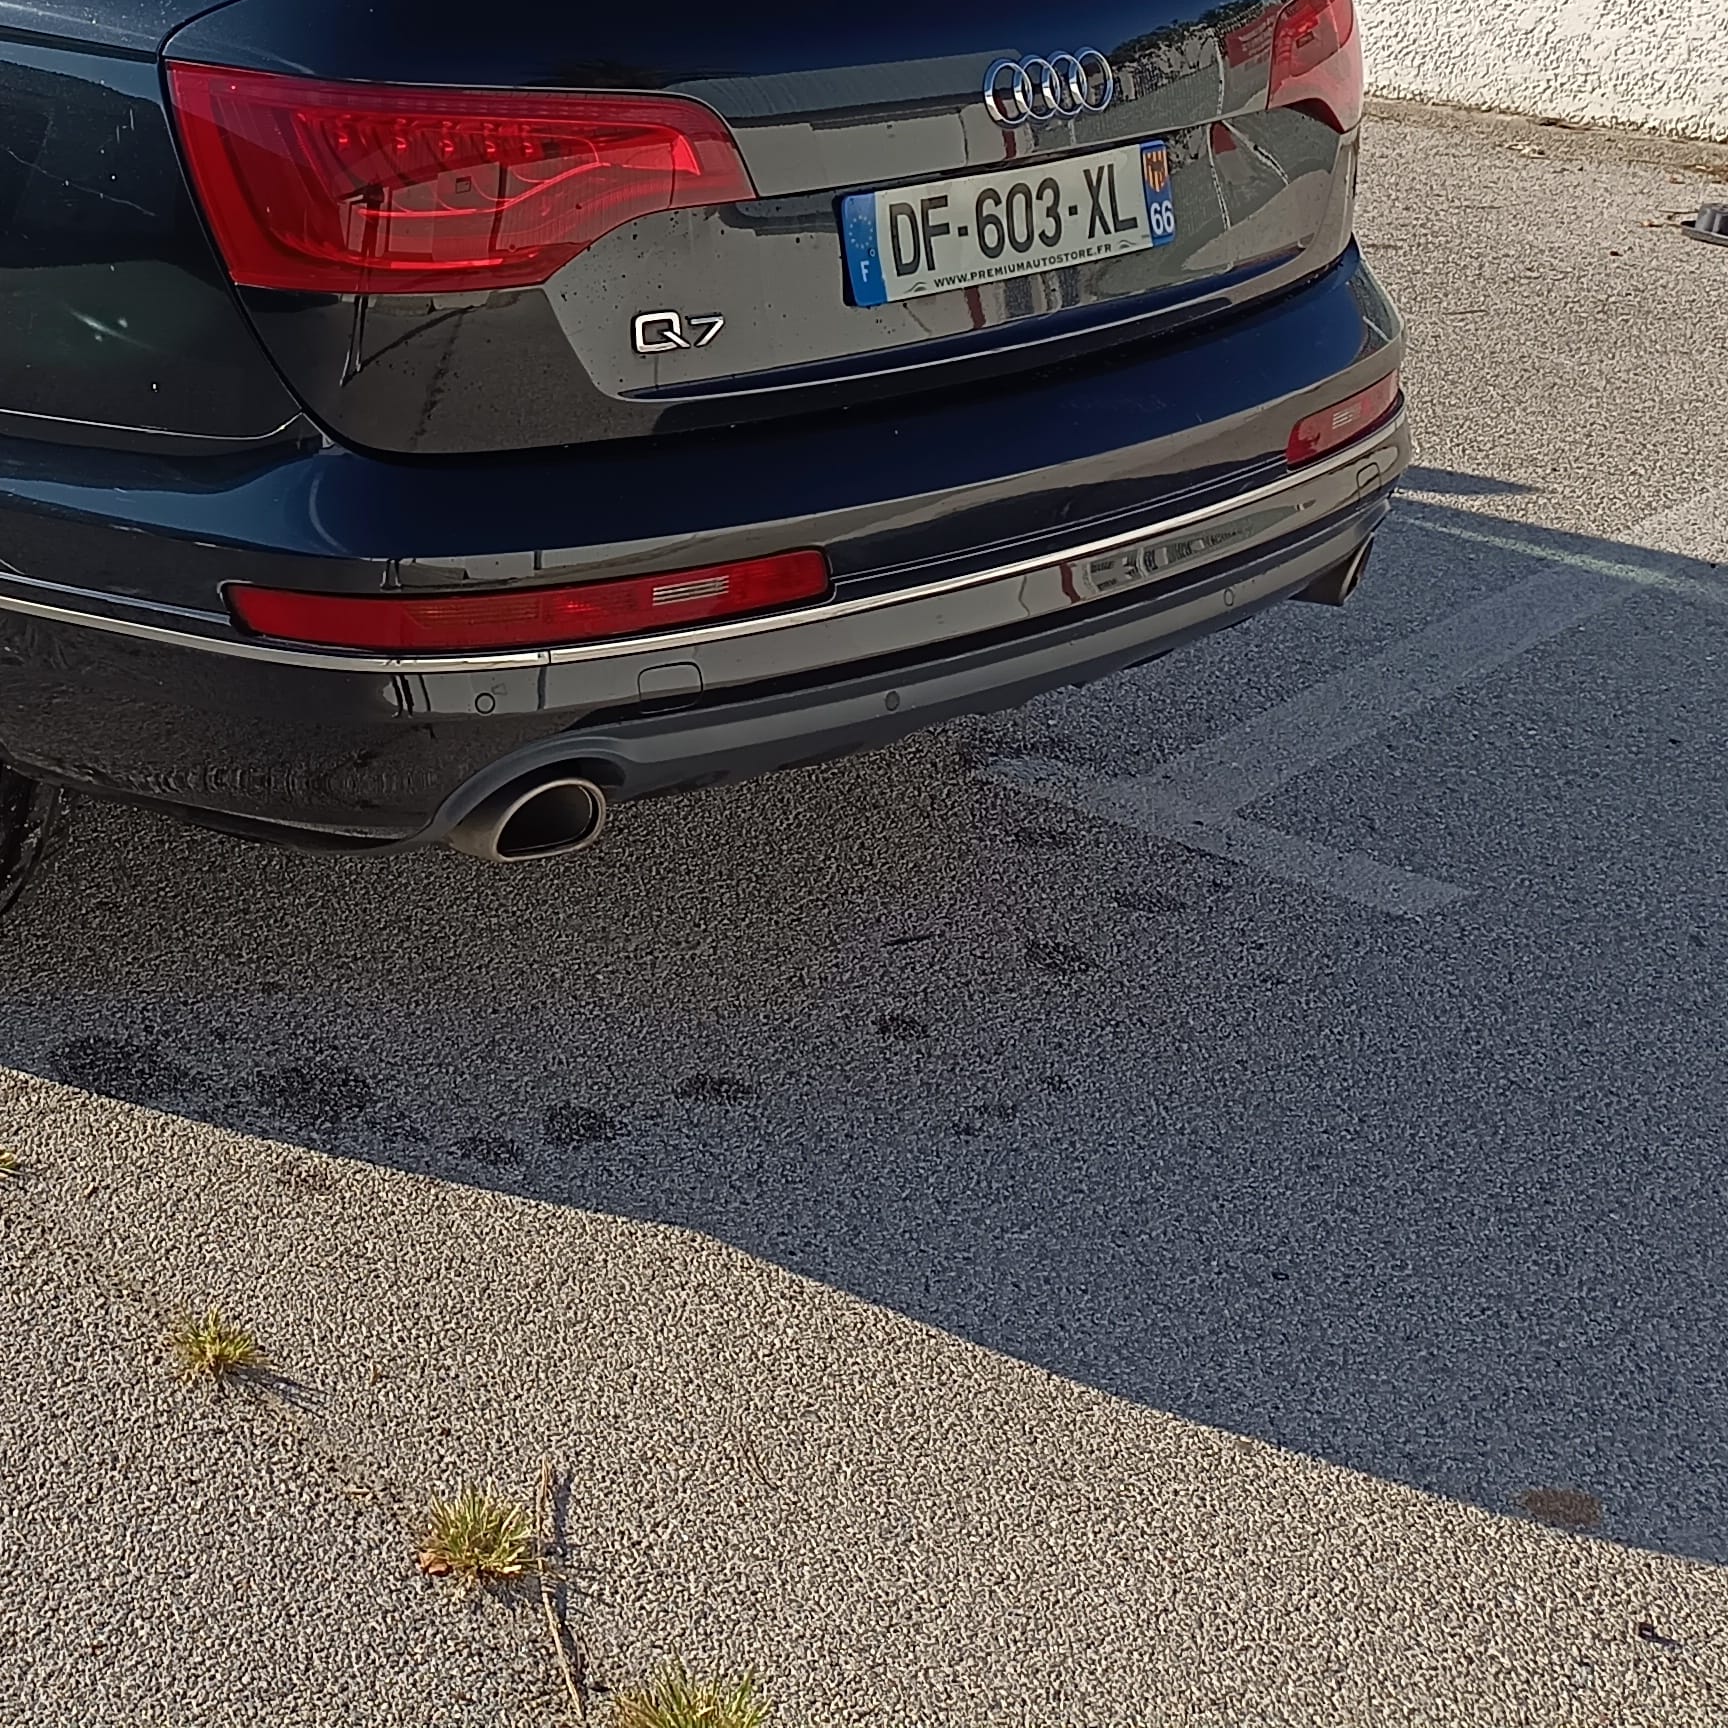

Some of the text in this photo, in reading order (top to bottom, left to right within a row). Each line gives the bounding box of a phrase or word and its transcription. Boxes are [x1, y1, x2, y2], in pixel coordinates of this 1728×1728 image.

[889, 163, 1138, 277] DF-603-XL
[1150, 200, 1173, 236] 66
[860, 260, 870, 283] F
[934, 242, 1112, 288] WWW.PREMIUMAUTOSTORE.FR
[630, 309, 726, 354] Q7
